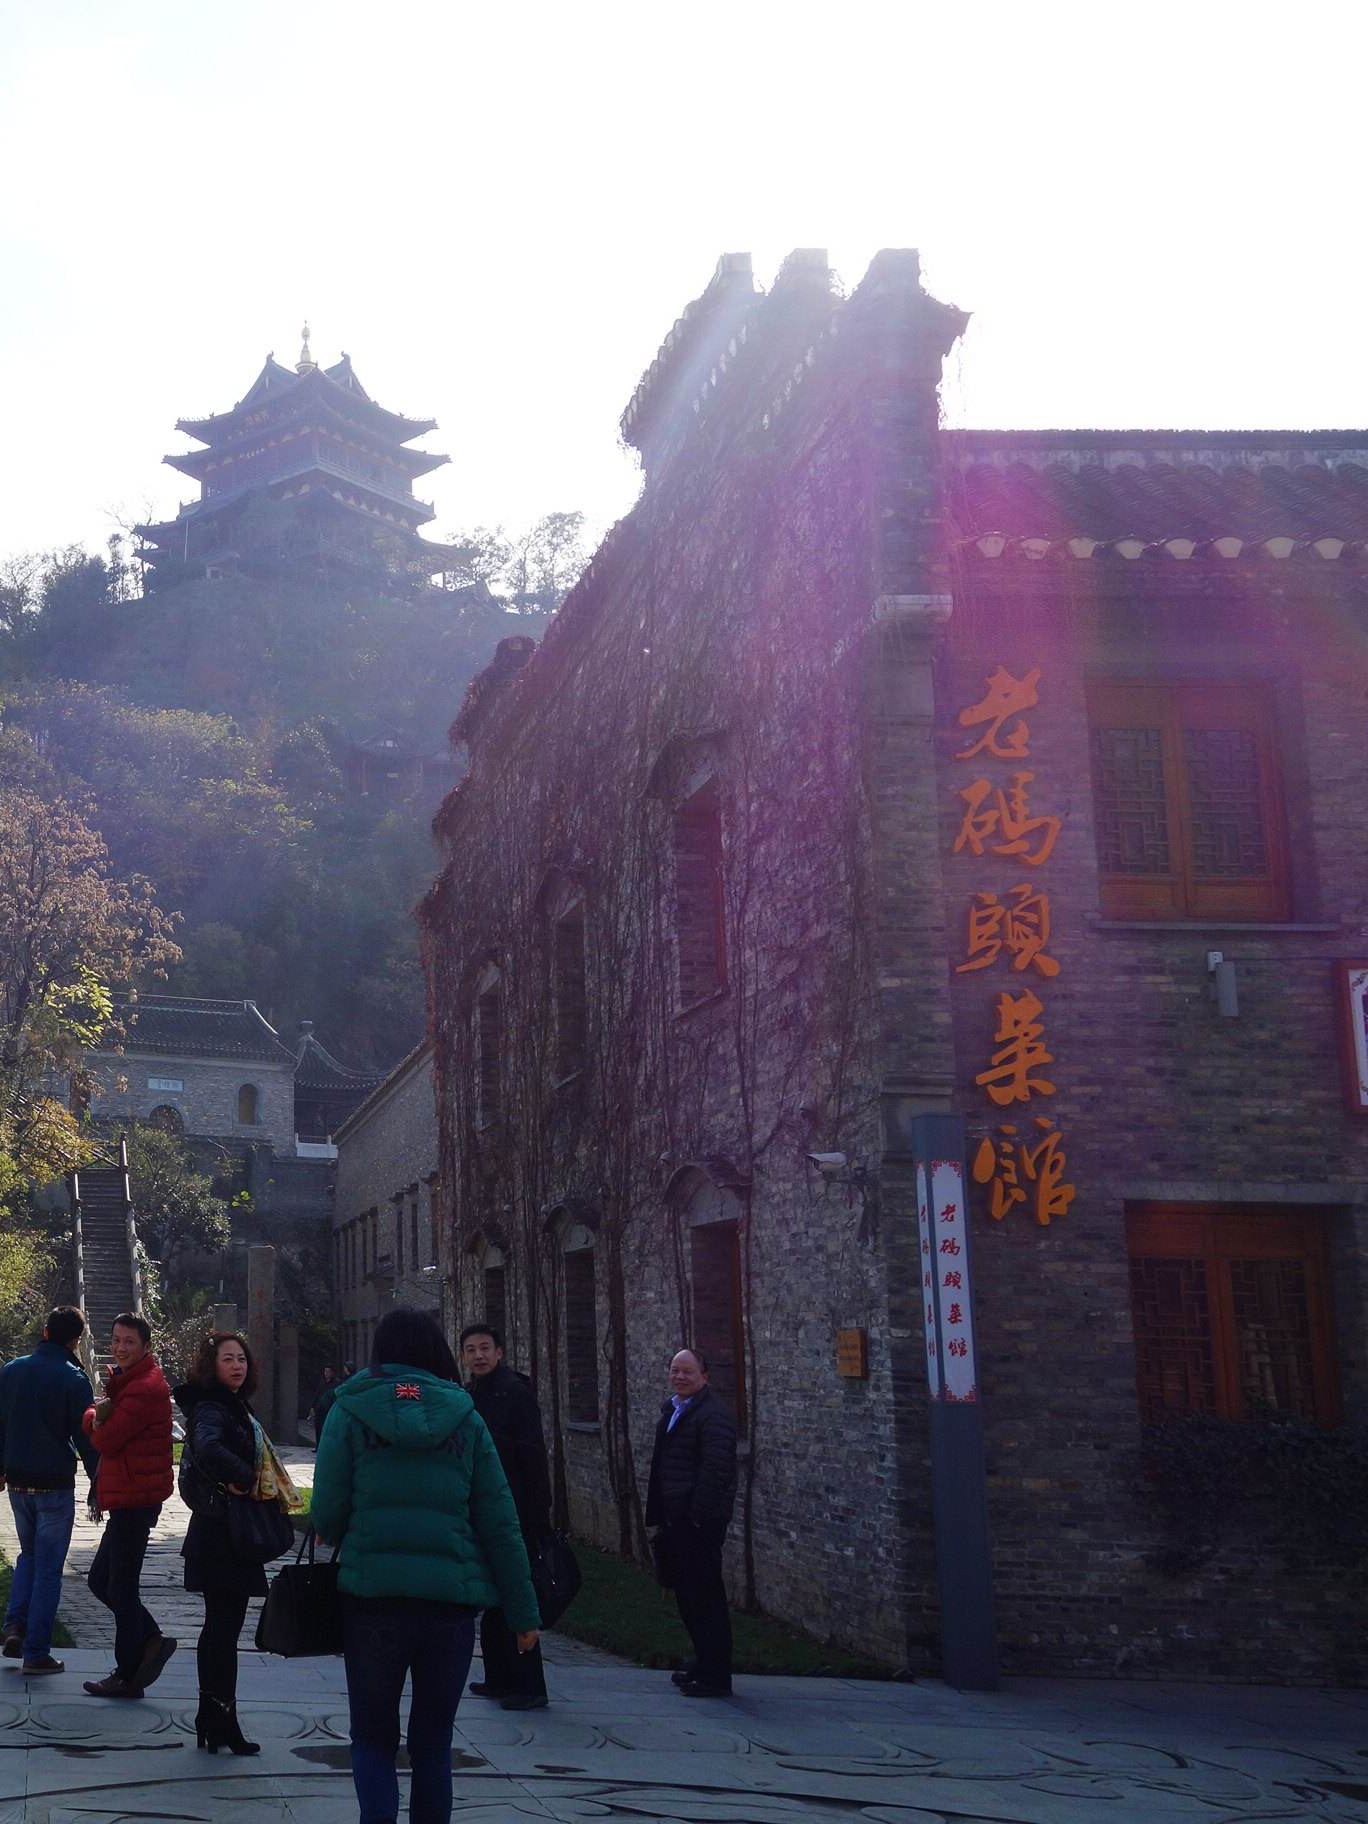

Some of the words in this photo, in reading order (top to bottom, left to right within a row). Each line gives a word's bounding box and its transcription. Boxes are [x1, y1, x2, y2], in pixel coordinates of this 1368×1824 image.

[954, 665, 1076, 1226] 老碼頭菜館
[939, 1204, 968, 1357] 老碼頭菜館
